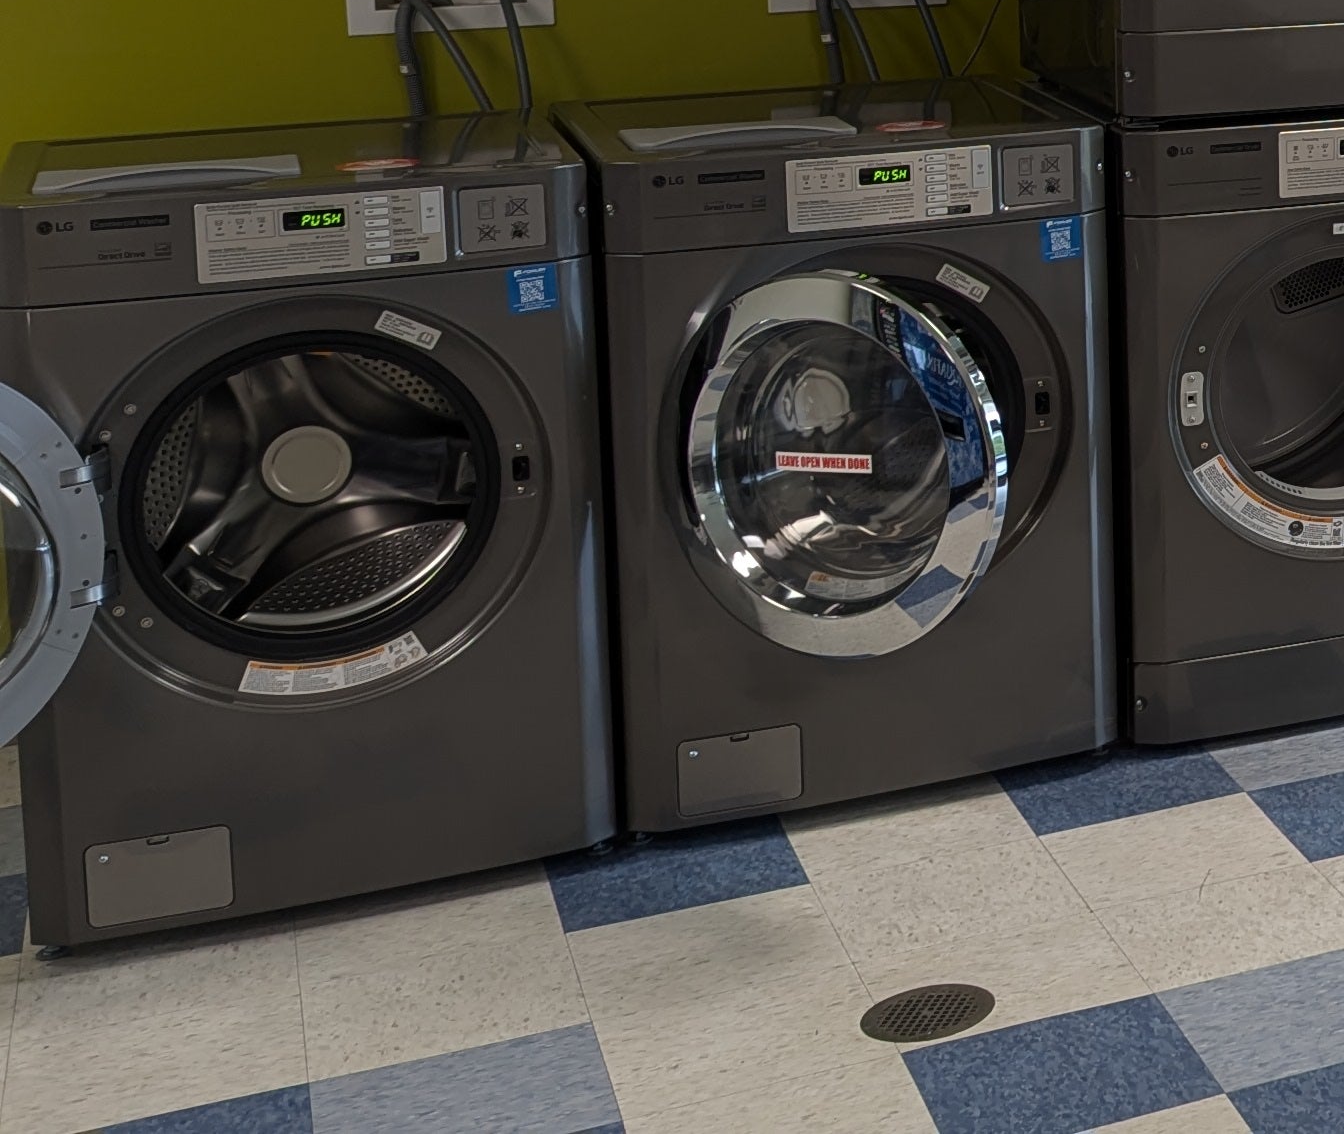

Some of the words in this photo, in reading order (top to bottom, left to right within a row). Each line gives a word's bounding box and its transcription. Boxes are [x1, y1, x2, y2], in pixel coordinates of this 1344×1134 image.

[1180, 146, 1193, 156] LG
[669, 176, 685, 186] LG
[873, 169, 908, 182] PUSH
[301, 213, 342, 227] PUSH
[56, 221, 74, 233] LG
[778, 455, 800, 467] LEAVE
[801, 456, 821, 468] OPEN
[822, 457, 846, 469] WHEN
[848, 458, 870, 470] DONE
